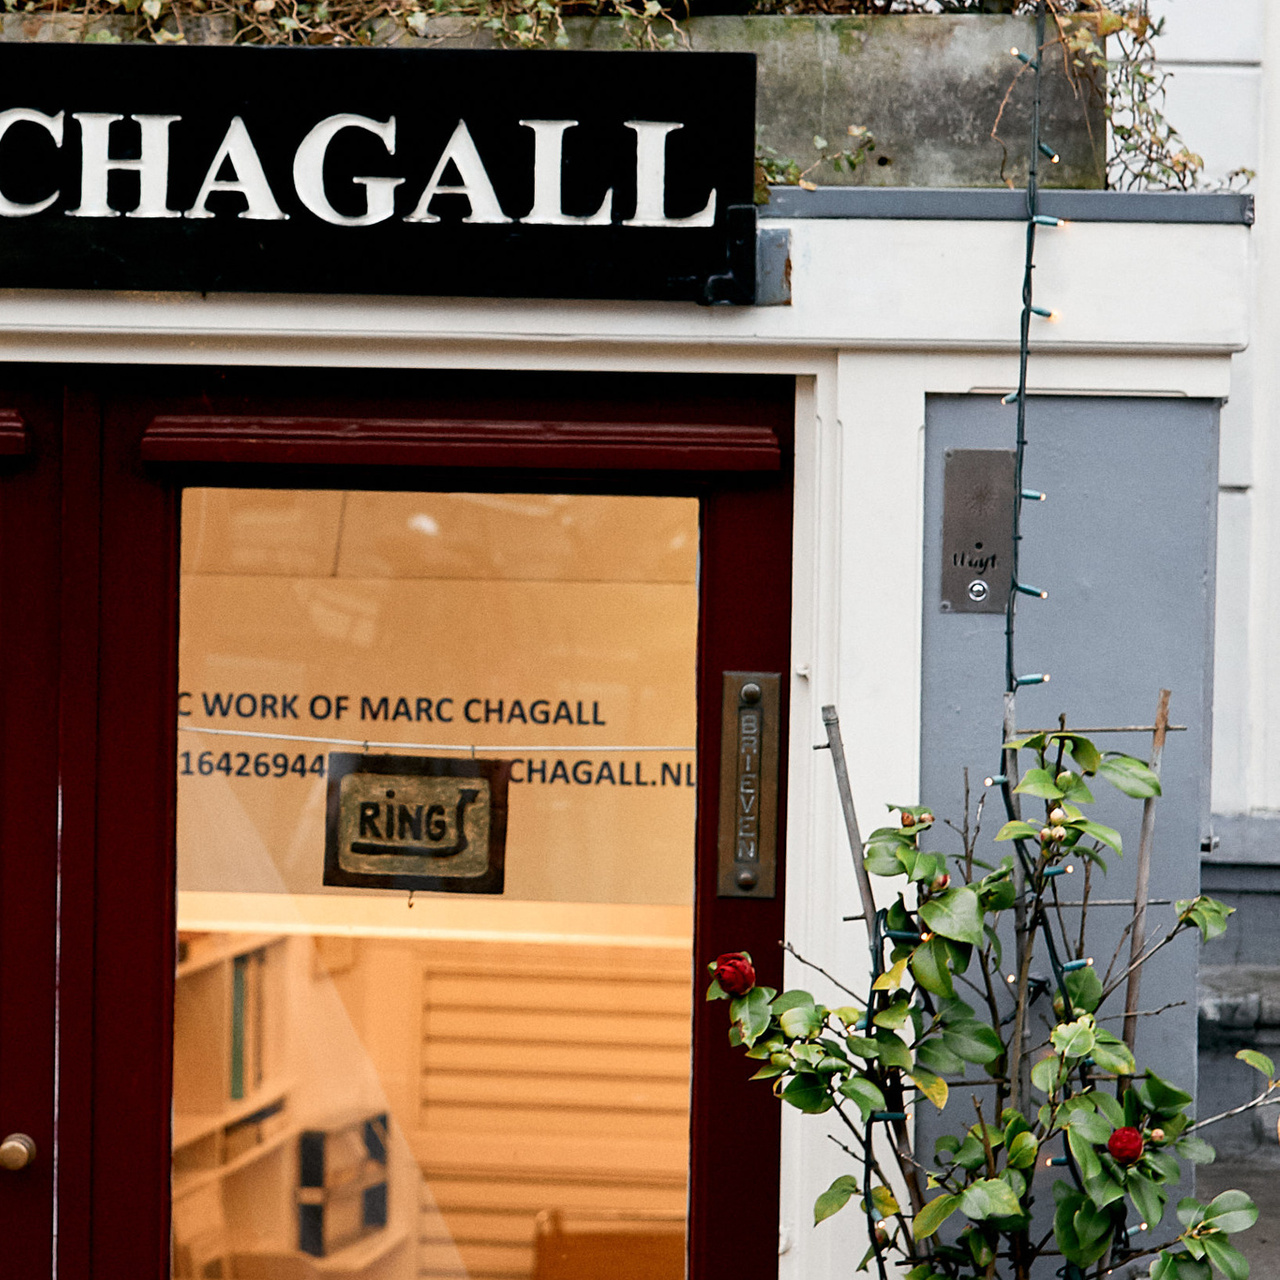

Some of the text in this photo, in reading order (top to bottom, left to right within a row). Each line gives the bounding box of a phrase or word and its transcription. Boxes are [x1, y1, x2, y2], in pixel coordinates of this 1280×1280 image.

[201, 693, 299, 720] WORK
[309, 694, 349, 721] OF
[360, 696, 454, 723] MARC
[463, 698, 606, 726] CHAGALL
[737, 714, 759, 859] BRIEVEN
